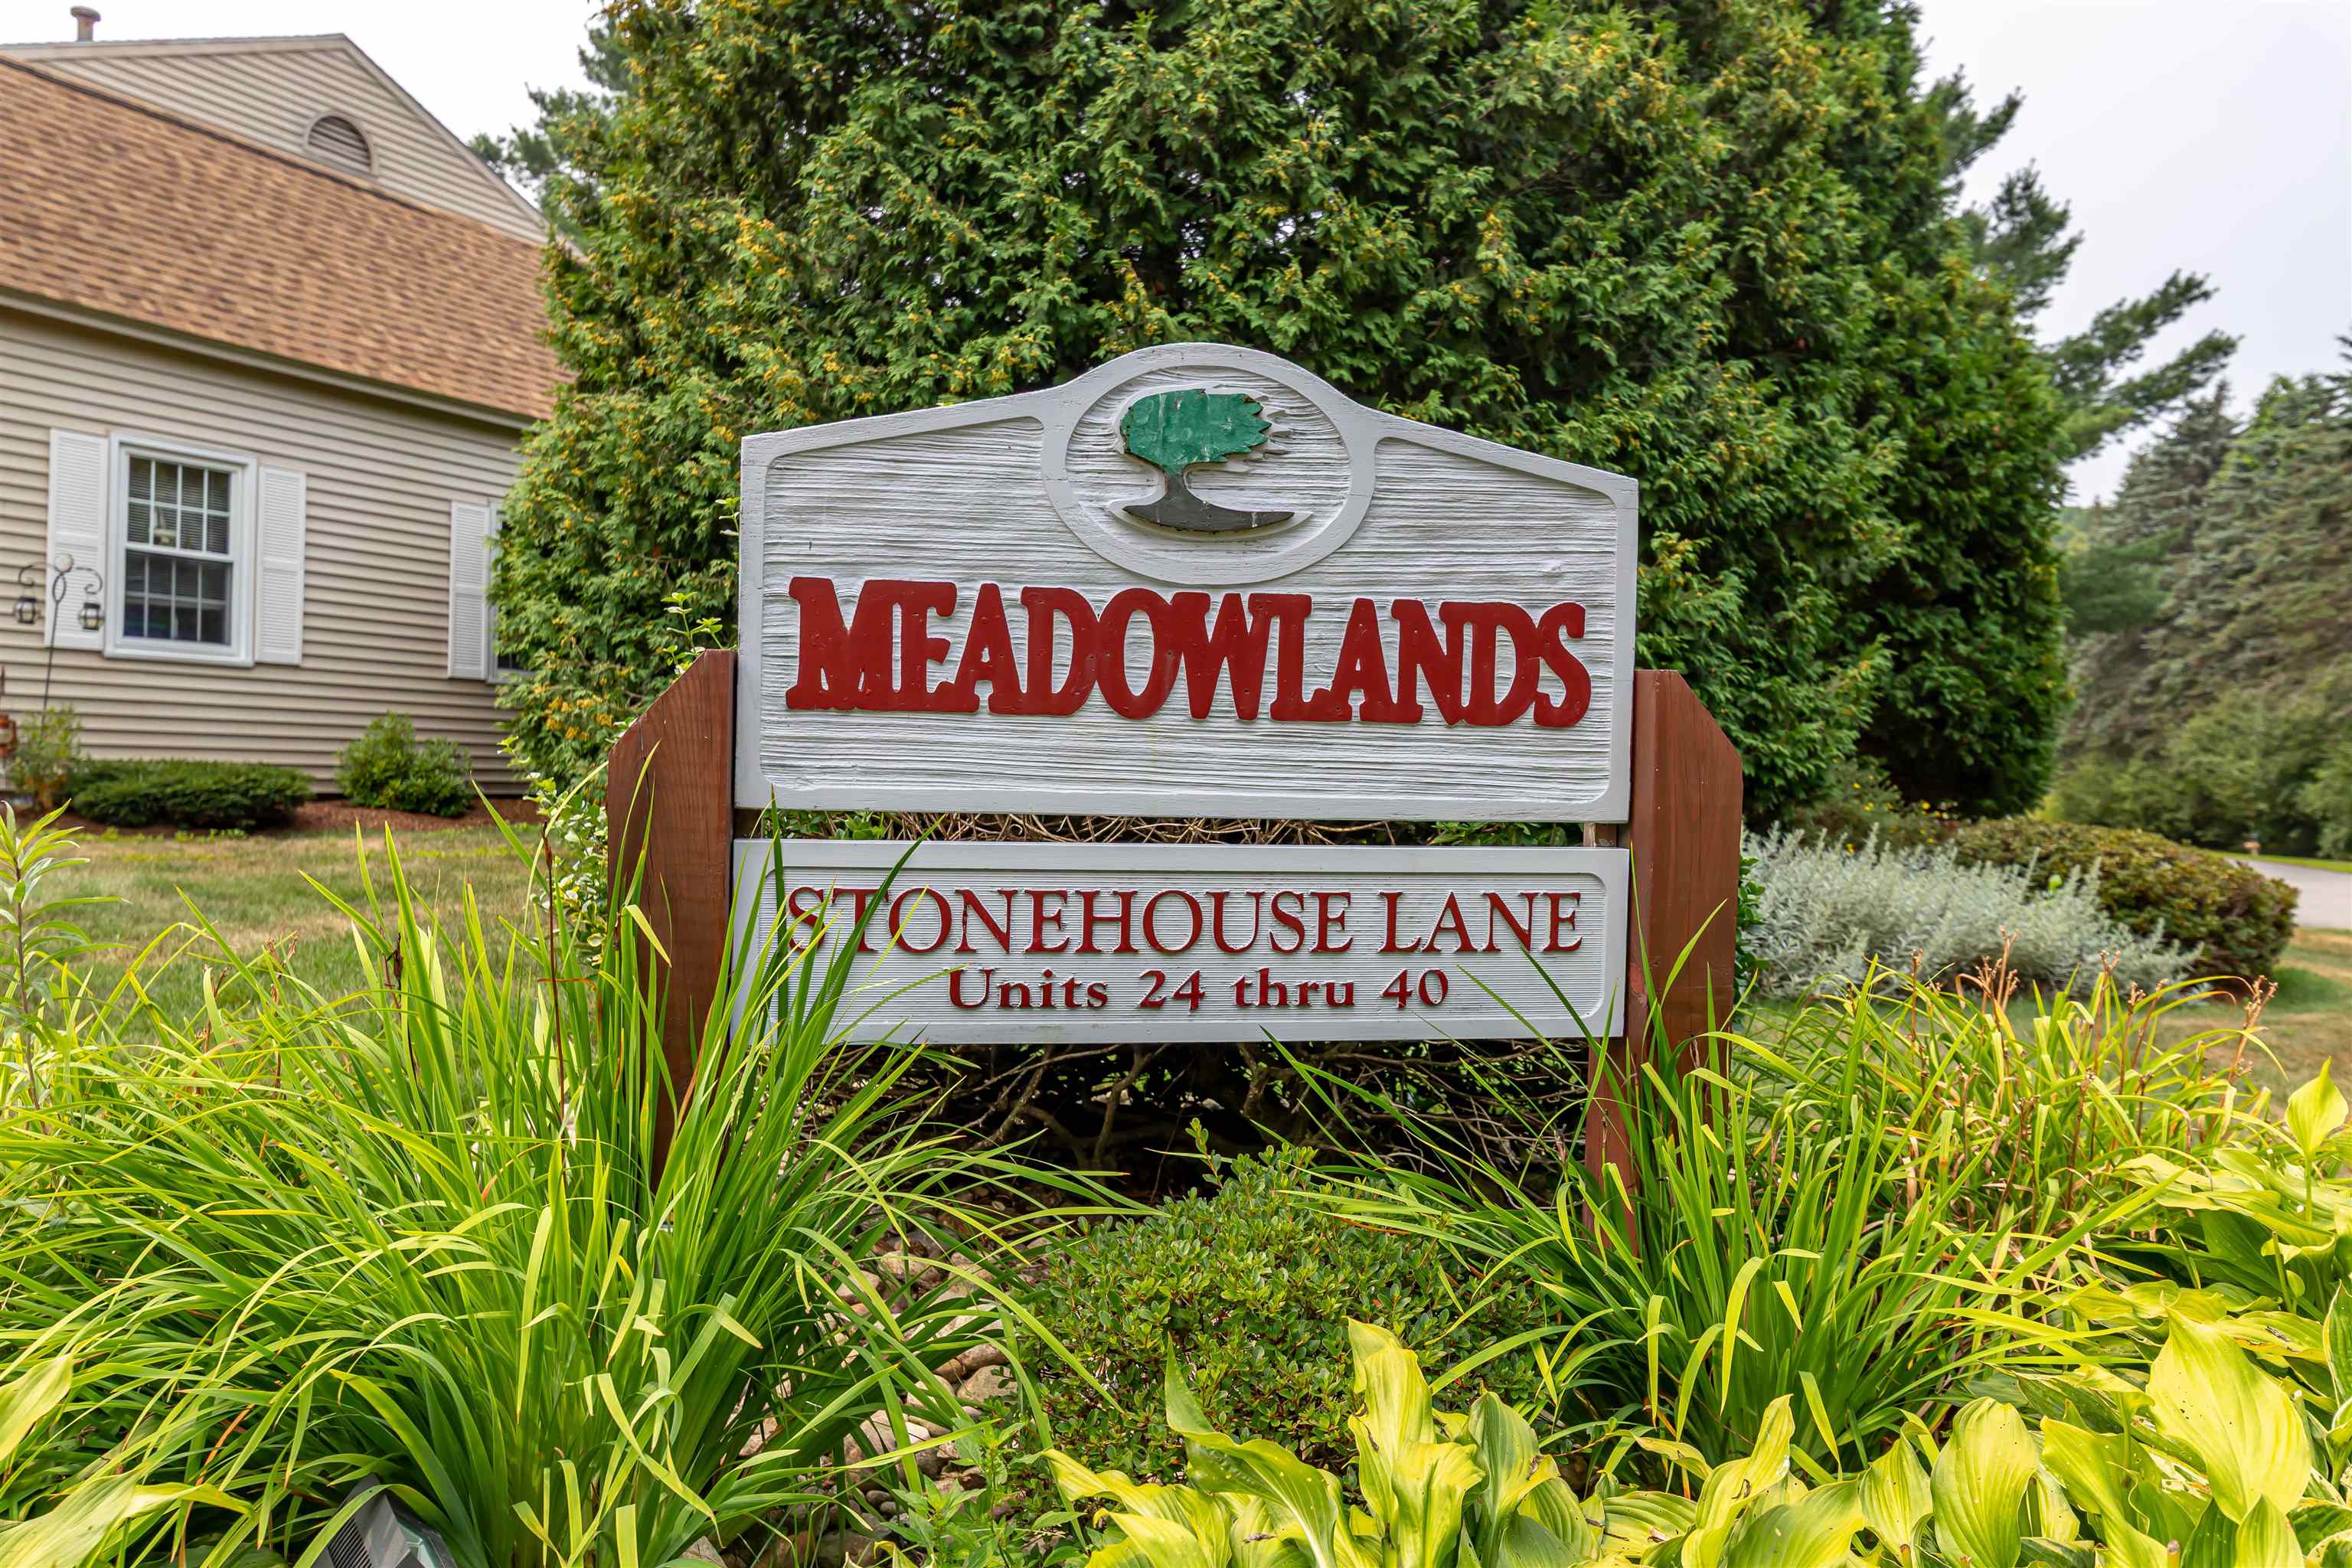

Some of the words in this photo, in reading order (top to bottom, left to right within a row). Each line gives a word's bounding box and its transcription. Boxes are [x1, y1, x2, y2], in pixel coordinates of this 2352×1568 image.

[786, 576, 1592, 729] MEADOWLANDS
[788, 886, 1354, 955] STONEHOUSE
[1378, 891, 1583, 954] LANE
[948, 968, 1109, 1009] Units
[1138, 969, 1206, 1011] 24
[1232, 967, 1355, 1008] thru
[1381, 969, 1449, 1009] 40
